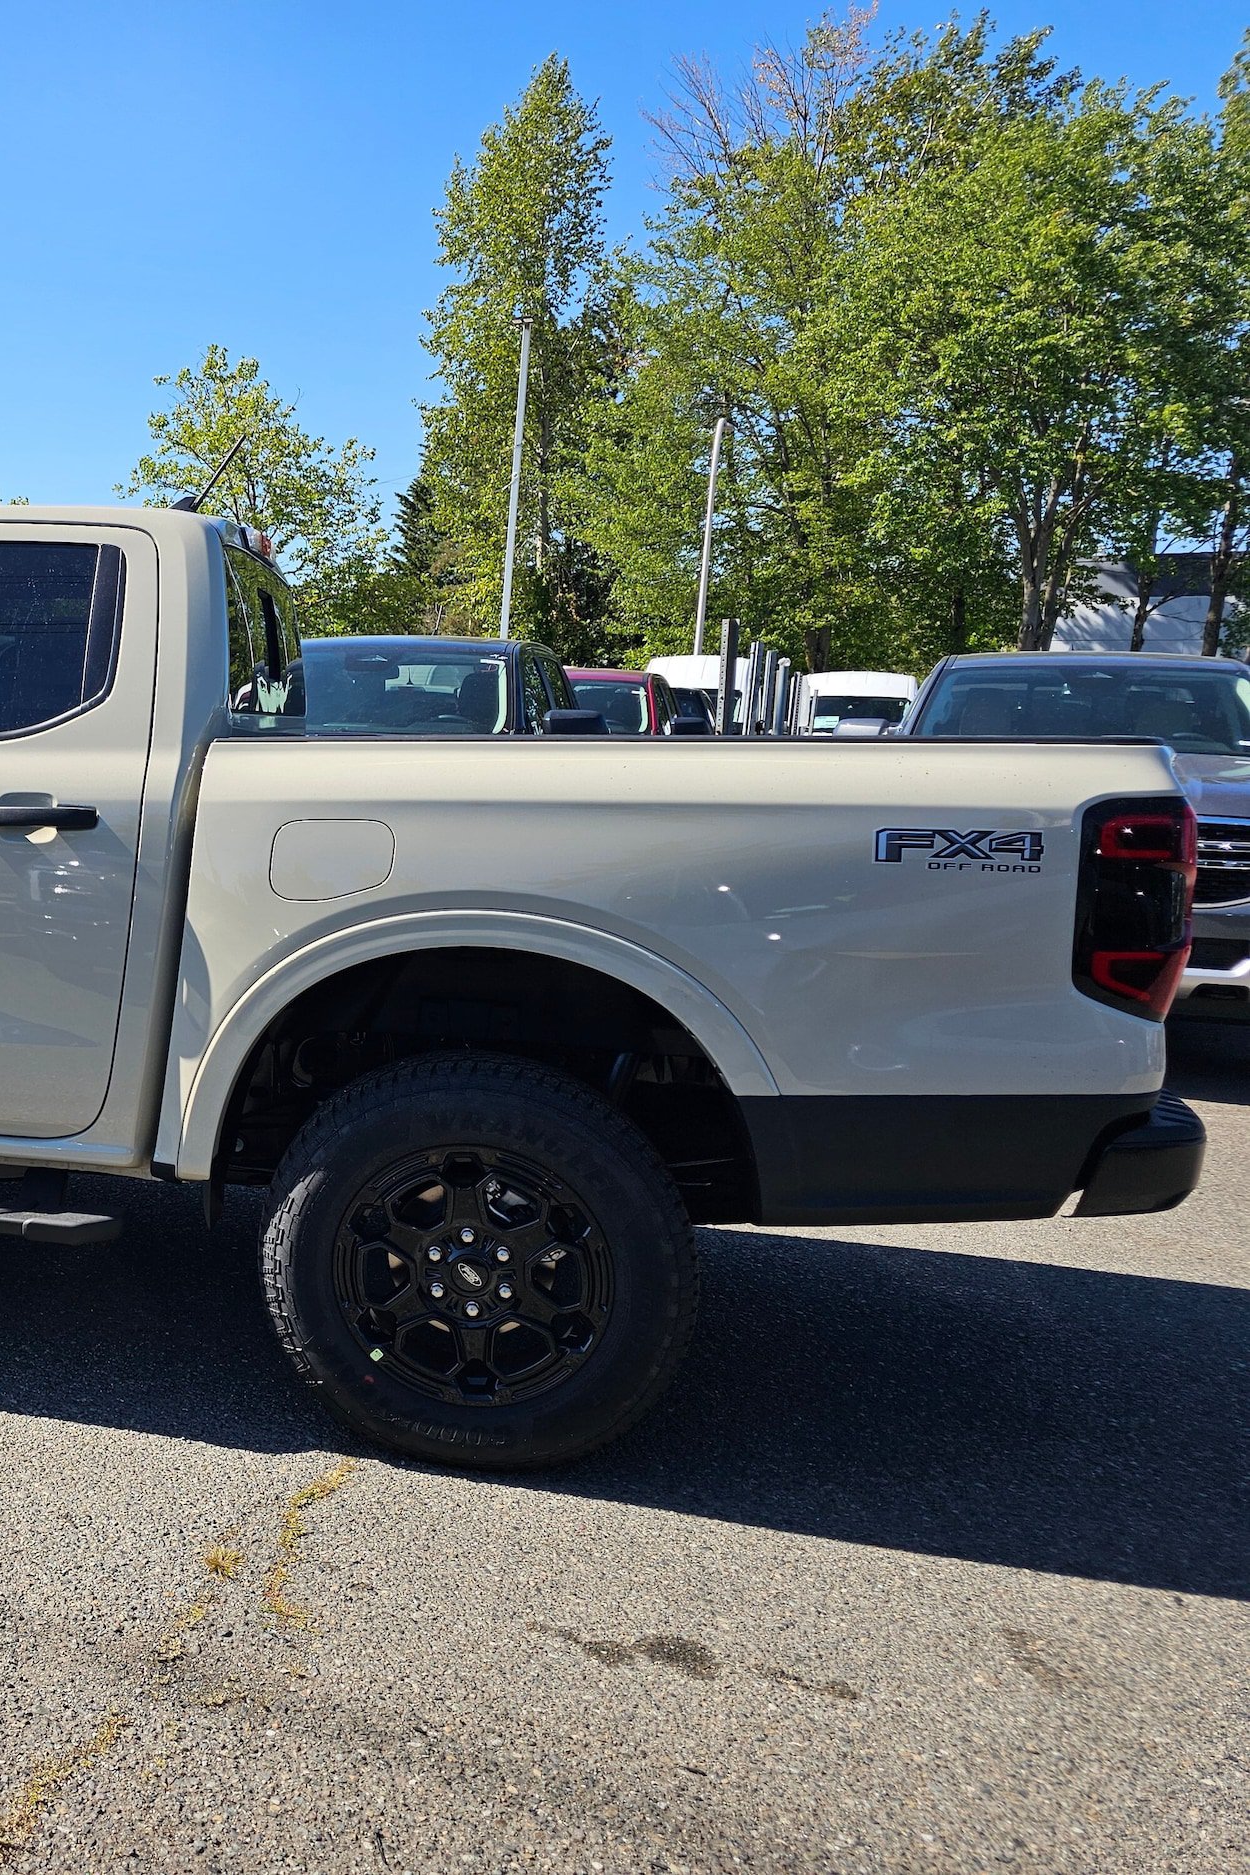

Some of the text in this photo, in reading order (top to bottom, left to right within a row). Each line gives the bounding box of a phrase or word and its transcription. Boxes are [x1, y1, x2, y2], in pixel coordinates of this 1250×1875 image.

[874, 827, 1045, 863] FX4
[927, 862, 1041, 873] OFF ROAD
